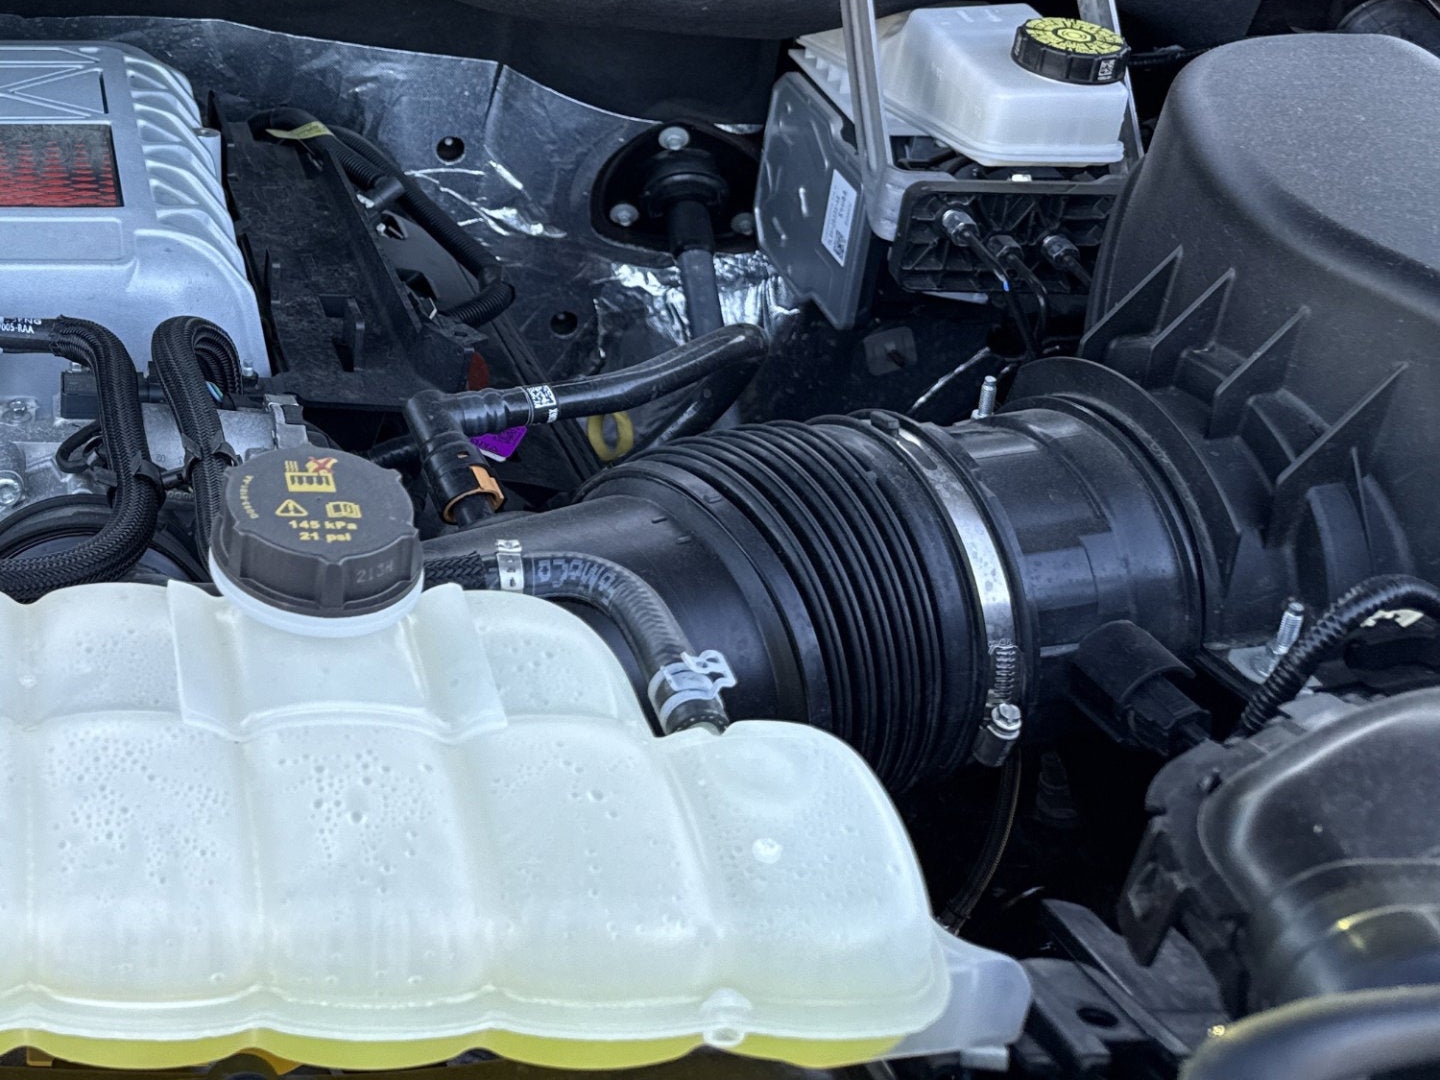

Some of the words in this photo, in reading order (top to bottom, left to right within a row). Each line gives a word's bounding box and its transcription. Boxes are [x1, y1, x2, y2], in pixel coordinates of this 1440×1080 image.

[288, 520, 320, 529] 145
[324, 520, 358, 530] kPa
[299, 531, 320, 541] 21
[325, 532, 352, 543] psi
